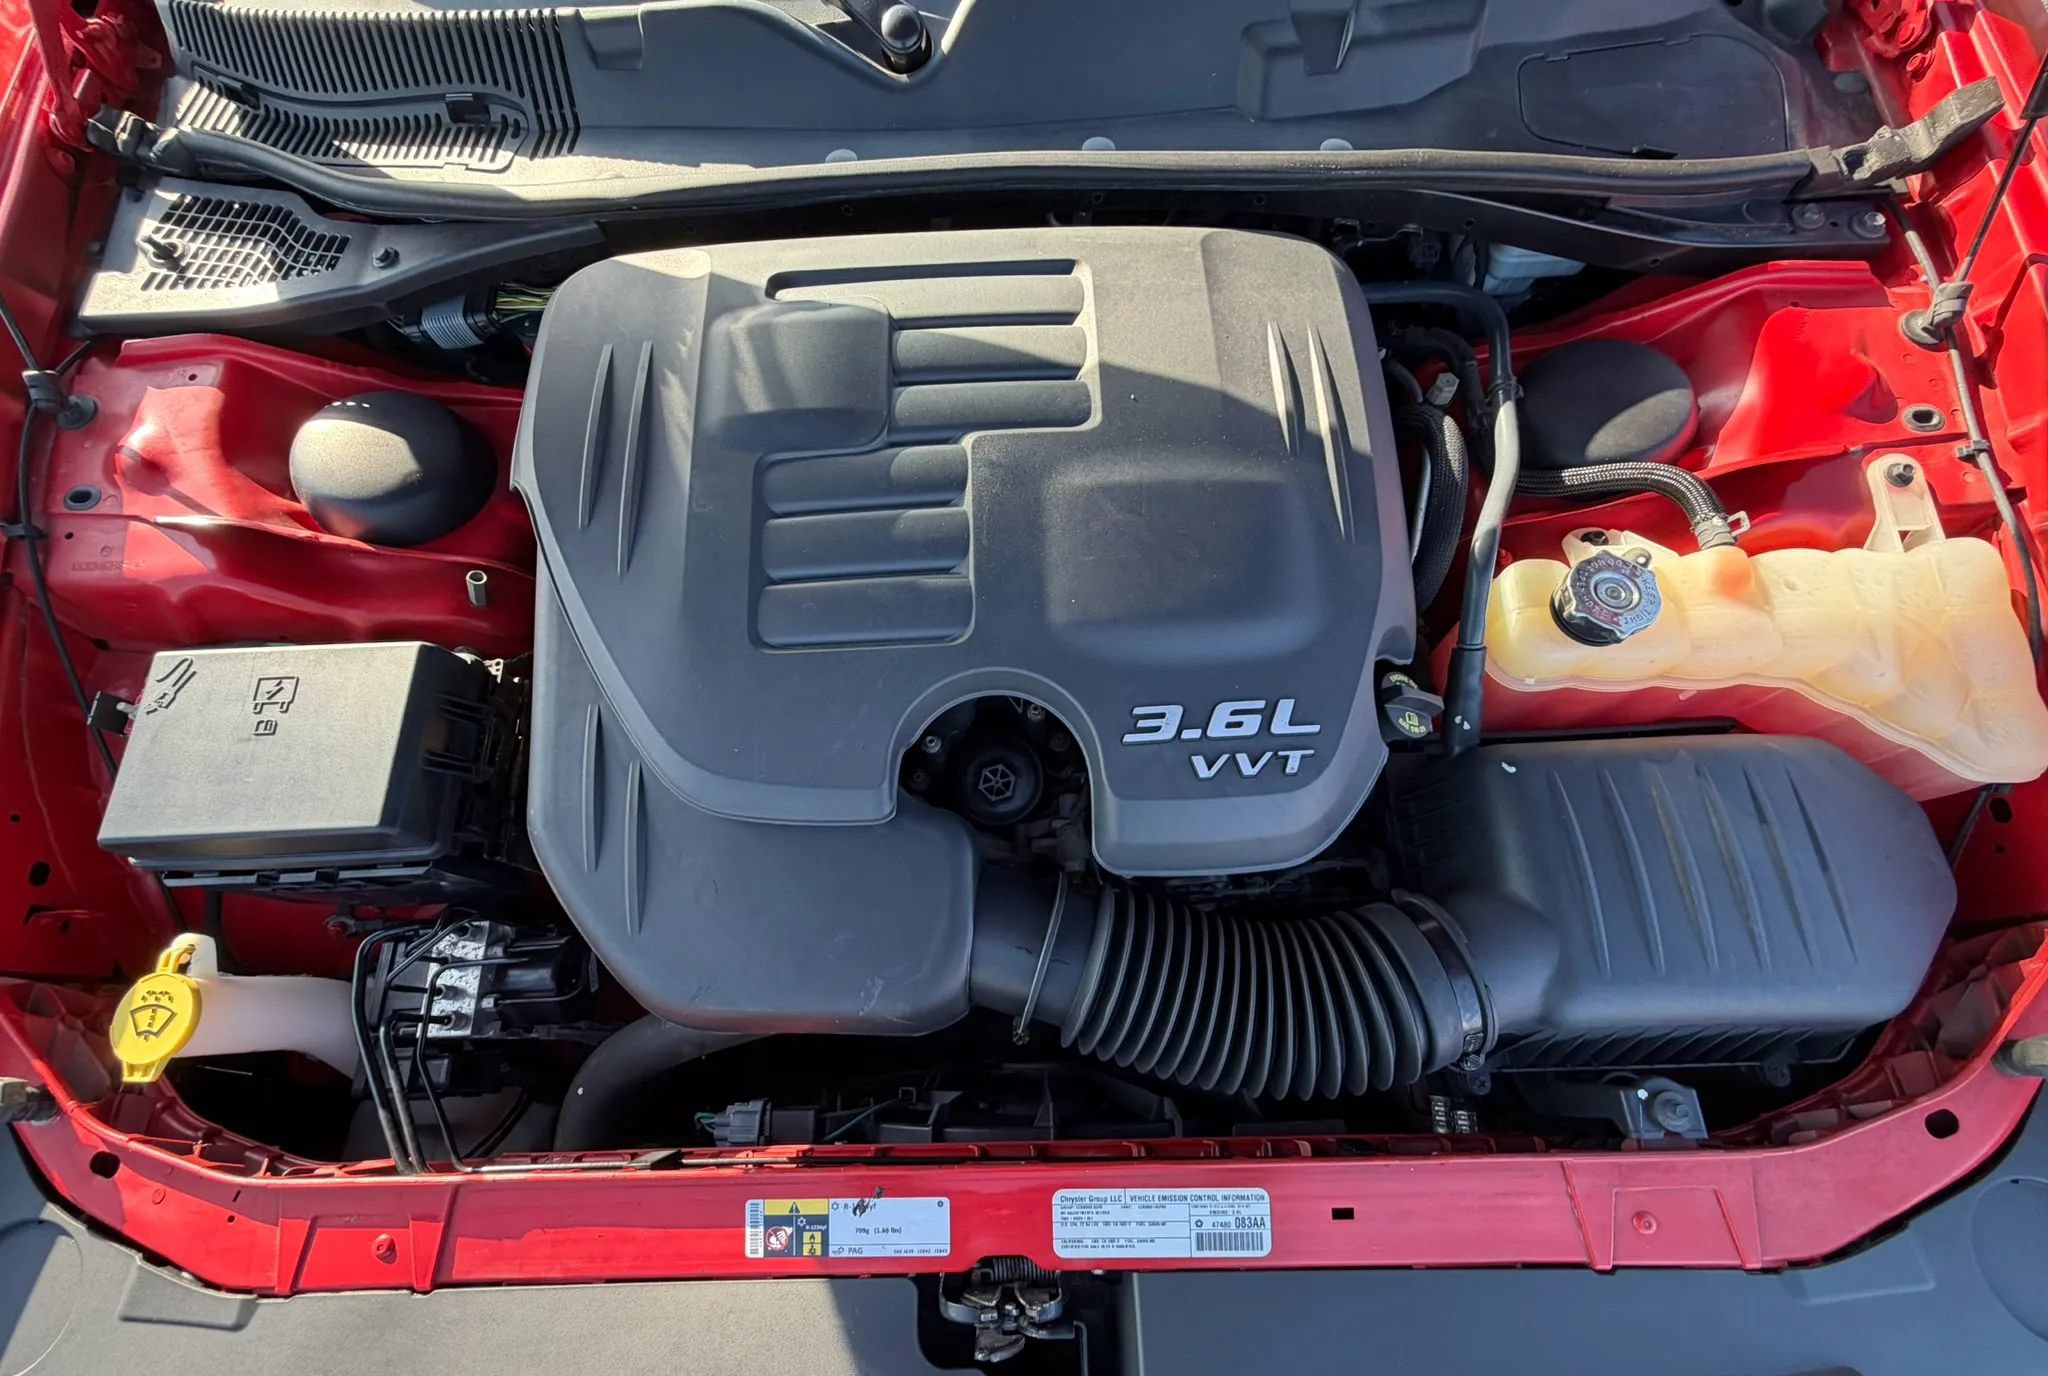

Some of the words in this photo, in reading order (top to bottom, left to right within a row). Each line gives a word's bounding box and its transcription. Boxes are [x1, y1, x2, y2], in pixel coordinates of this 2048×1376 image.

[1122, 698, 1322, 745] 3.6L
[1190, 749, 1316, 780] VVT
[1060, 1194, 1086, 1204] Chrysler
[1088, 1195, 1108, 1204] Group
[1110, 1194, 1122, 1202] LLC
[1130, 1194, 1156, 1203] VEHICLE
[1158, 1194, 1188, 1202] EMISSION
[1190, 1194, 1219, 1202] CONTROL
[1221, 1193, 1265, 1202] INFORMATION
[1234, 1216, 1266, 1229] 083AA
[848, 1247, 864, 1255] PAG
